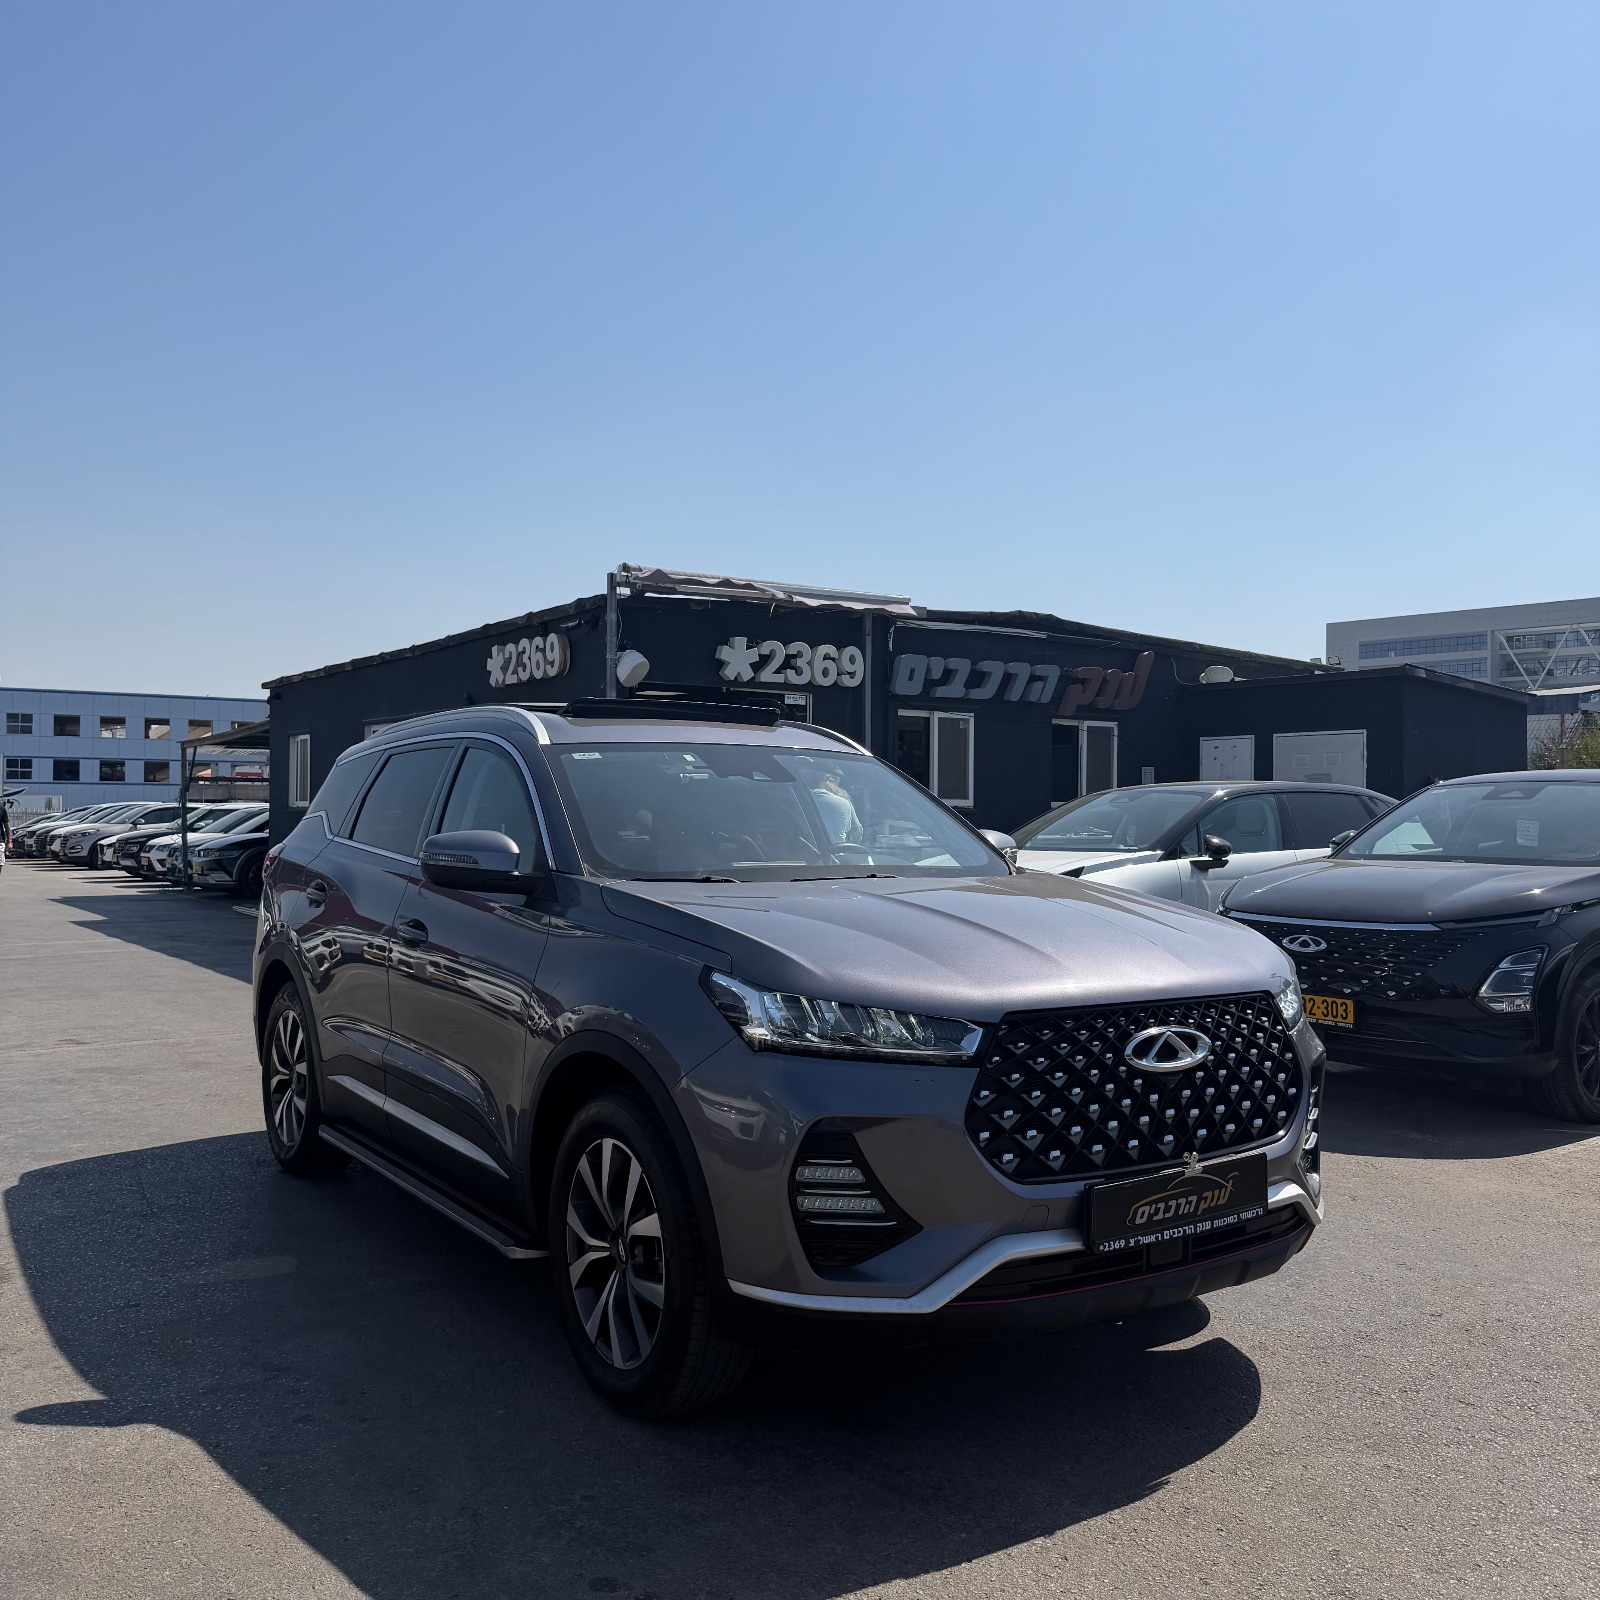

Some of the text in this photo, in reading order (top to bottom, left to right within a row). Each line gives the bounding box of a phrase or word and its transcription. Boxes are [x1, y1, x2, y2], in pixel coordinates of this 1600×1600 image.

[891, 651, 1155, 716] ענק הרכבים
[1135, 1179, 1233, 1225] ענק הרכבים
[1213, 1214, 1238, 1227] בסוכנות
[1240, 1207, 1263, 1220] נרכשתי
[1163, 1224, 1194, 1240] הרכבים
[1197, 1220, 1211, 1233] ענק
